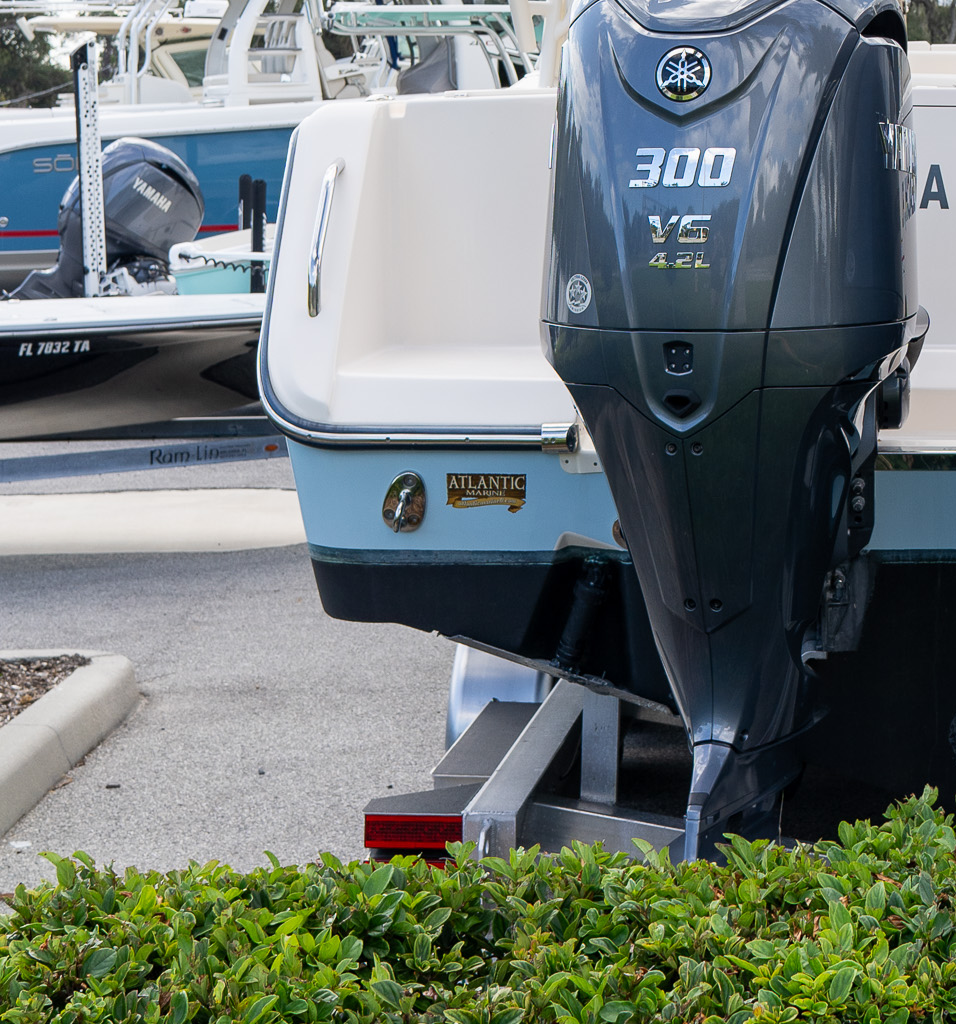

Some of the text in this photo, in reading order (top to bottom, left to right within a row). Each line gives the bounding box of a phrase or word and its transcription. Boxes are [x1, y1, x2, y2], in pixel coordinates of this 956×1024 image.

[33, 154, 80, 173] SŌ
[629, 147, 736, 188] 300
[133, 177, 173, 213] YAMAHA
[648, 215, 712, 243] V6
[648, 251, 711, 269] 4.2L
[18, 342, 33, 356] FL
[73, 339, 90, 352] TA
[448, 475, 526, 491] ATLANTIC
[465, 489, 506, 497] MARINE
